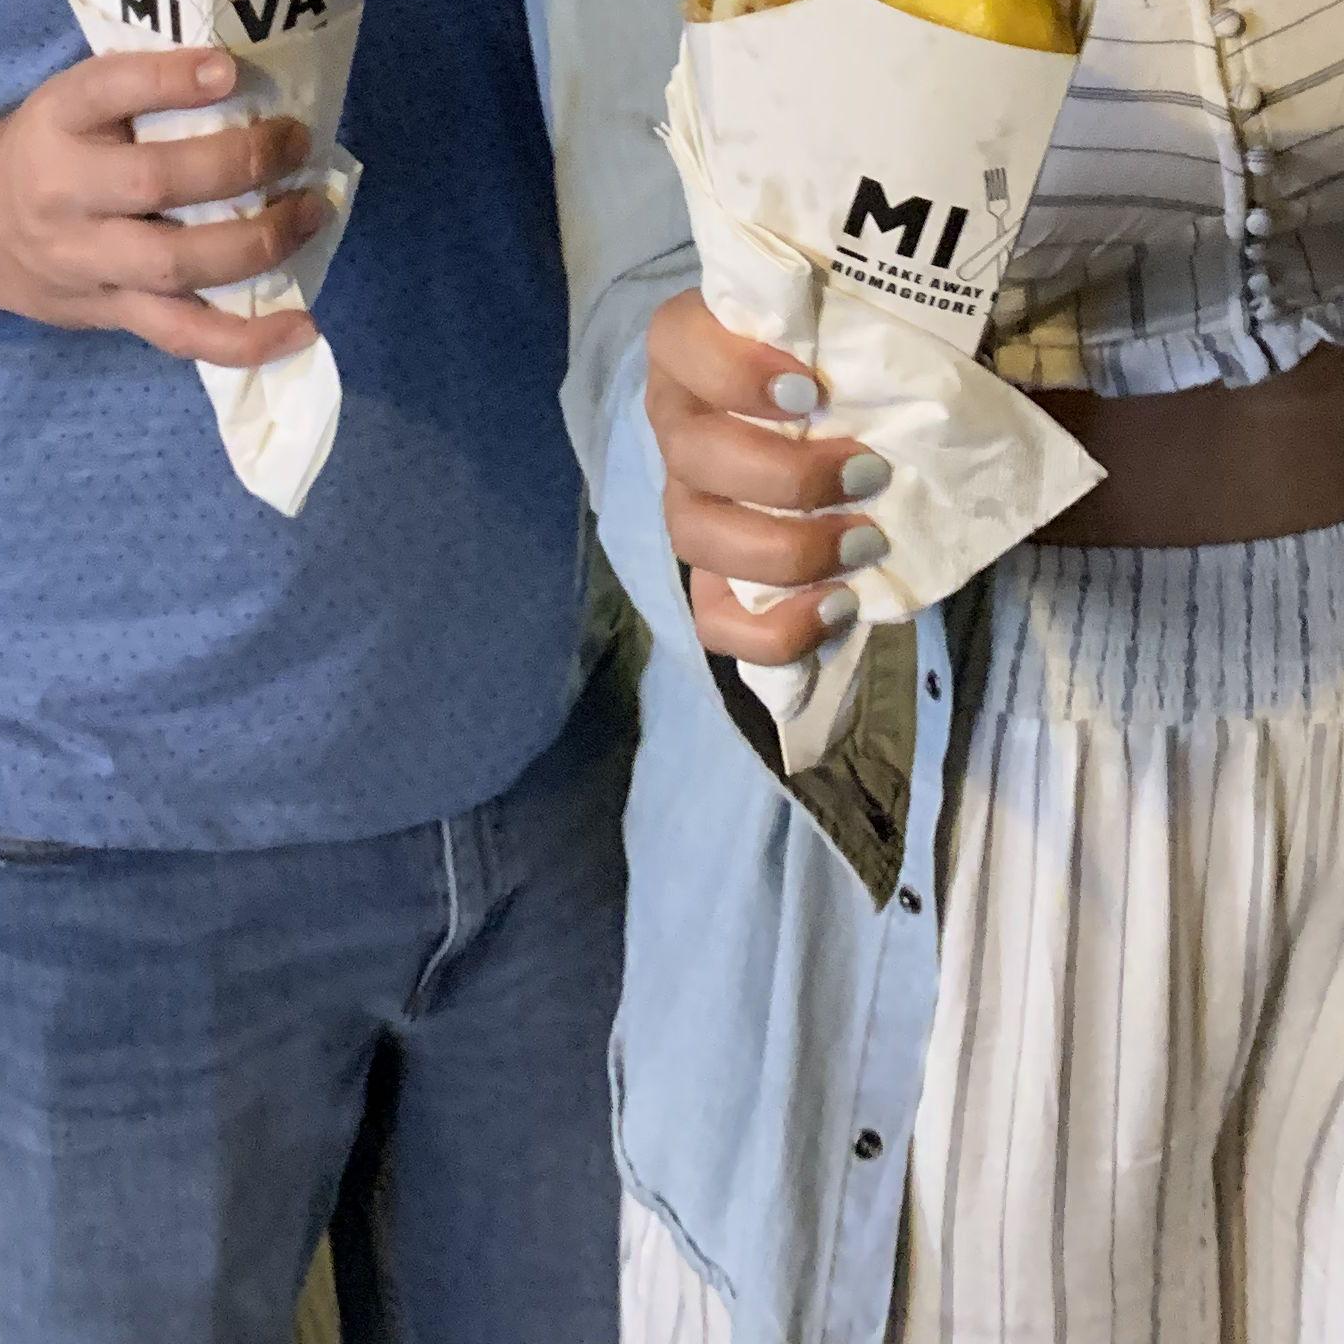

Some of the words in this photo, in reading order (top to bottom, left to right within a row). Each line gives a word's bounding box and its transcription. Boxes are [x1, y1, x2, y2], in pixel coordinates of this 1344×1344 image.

[843, 175, 969, 269] MI
[830, 259, 978, 316] RIOMAGGIORE
[877, 261, 924, 284] TAKE
[929, 277, 984, 299] AWAY
